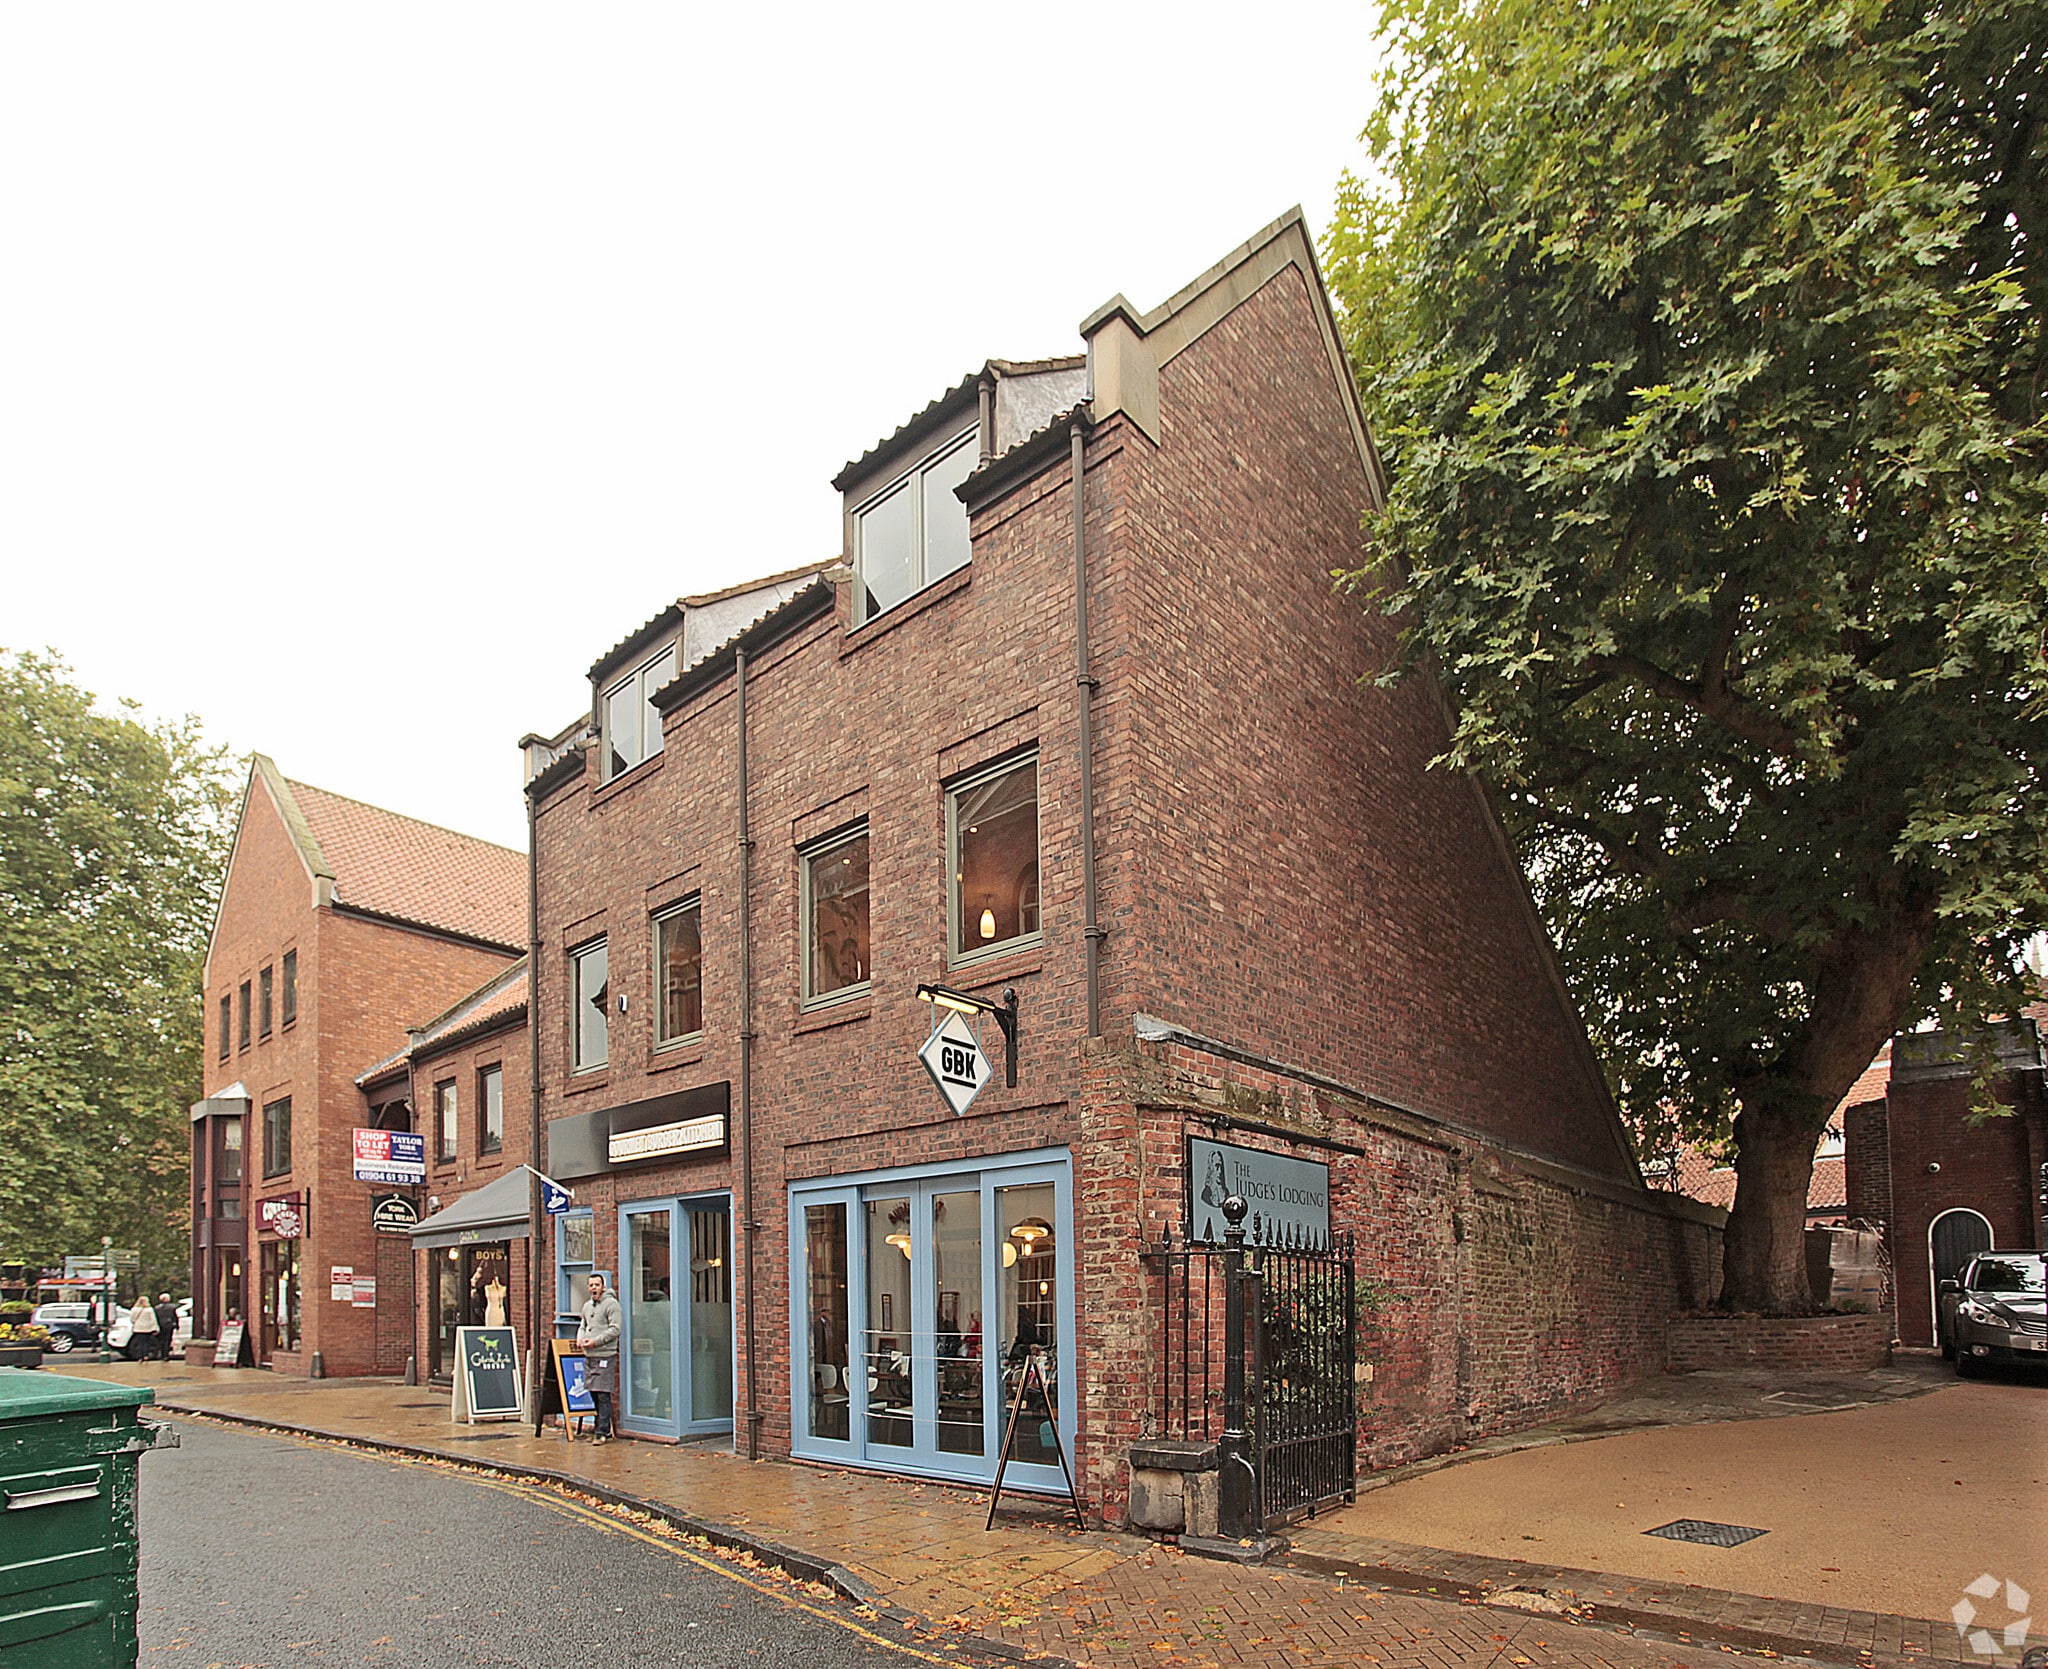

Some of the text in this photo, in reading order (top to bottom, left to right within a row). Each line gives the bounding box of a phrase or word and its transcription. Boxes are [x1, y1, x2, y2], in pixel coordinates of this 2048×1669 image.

[941, 1046, 977, 1080] GBK
[359, 1131, 387, 1140] SHOP
[391, 1135, 422, 1146] TAYLOR
[608, 1120, 724, 1157] GOURMET BURGER KITCHEN
[357, 1140, 390, 1150] TO LET
[356, 1161, 423, 1174] Business Relocating
[1234, 1161, 1251, 1178] THE
[358, 1171, 385, 1181] 01904
[386, 1173, 396, 1181] 61
[397, 1174, 409, 1182] 93
[1235, 1177, 1324, 1208] JUDGE'S LODGING
[387, 1204, 405, 1213] YORK
[475, 1250, 503, 1260] BOYS
